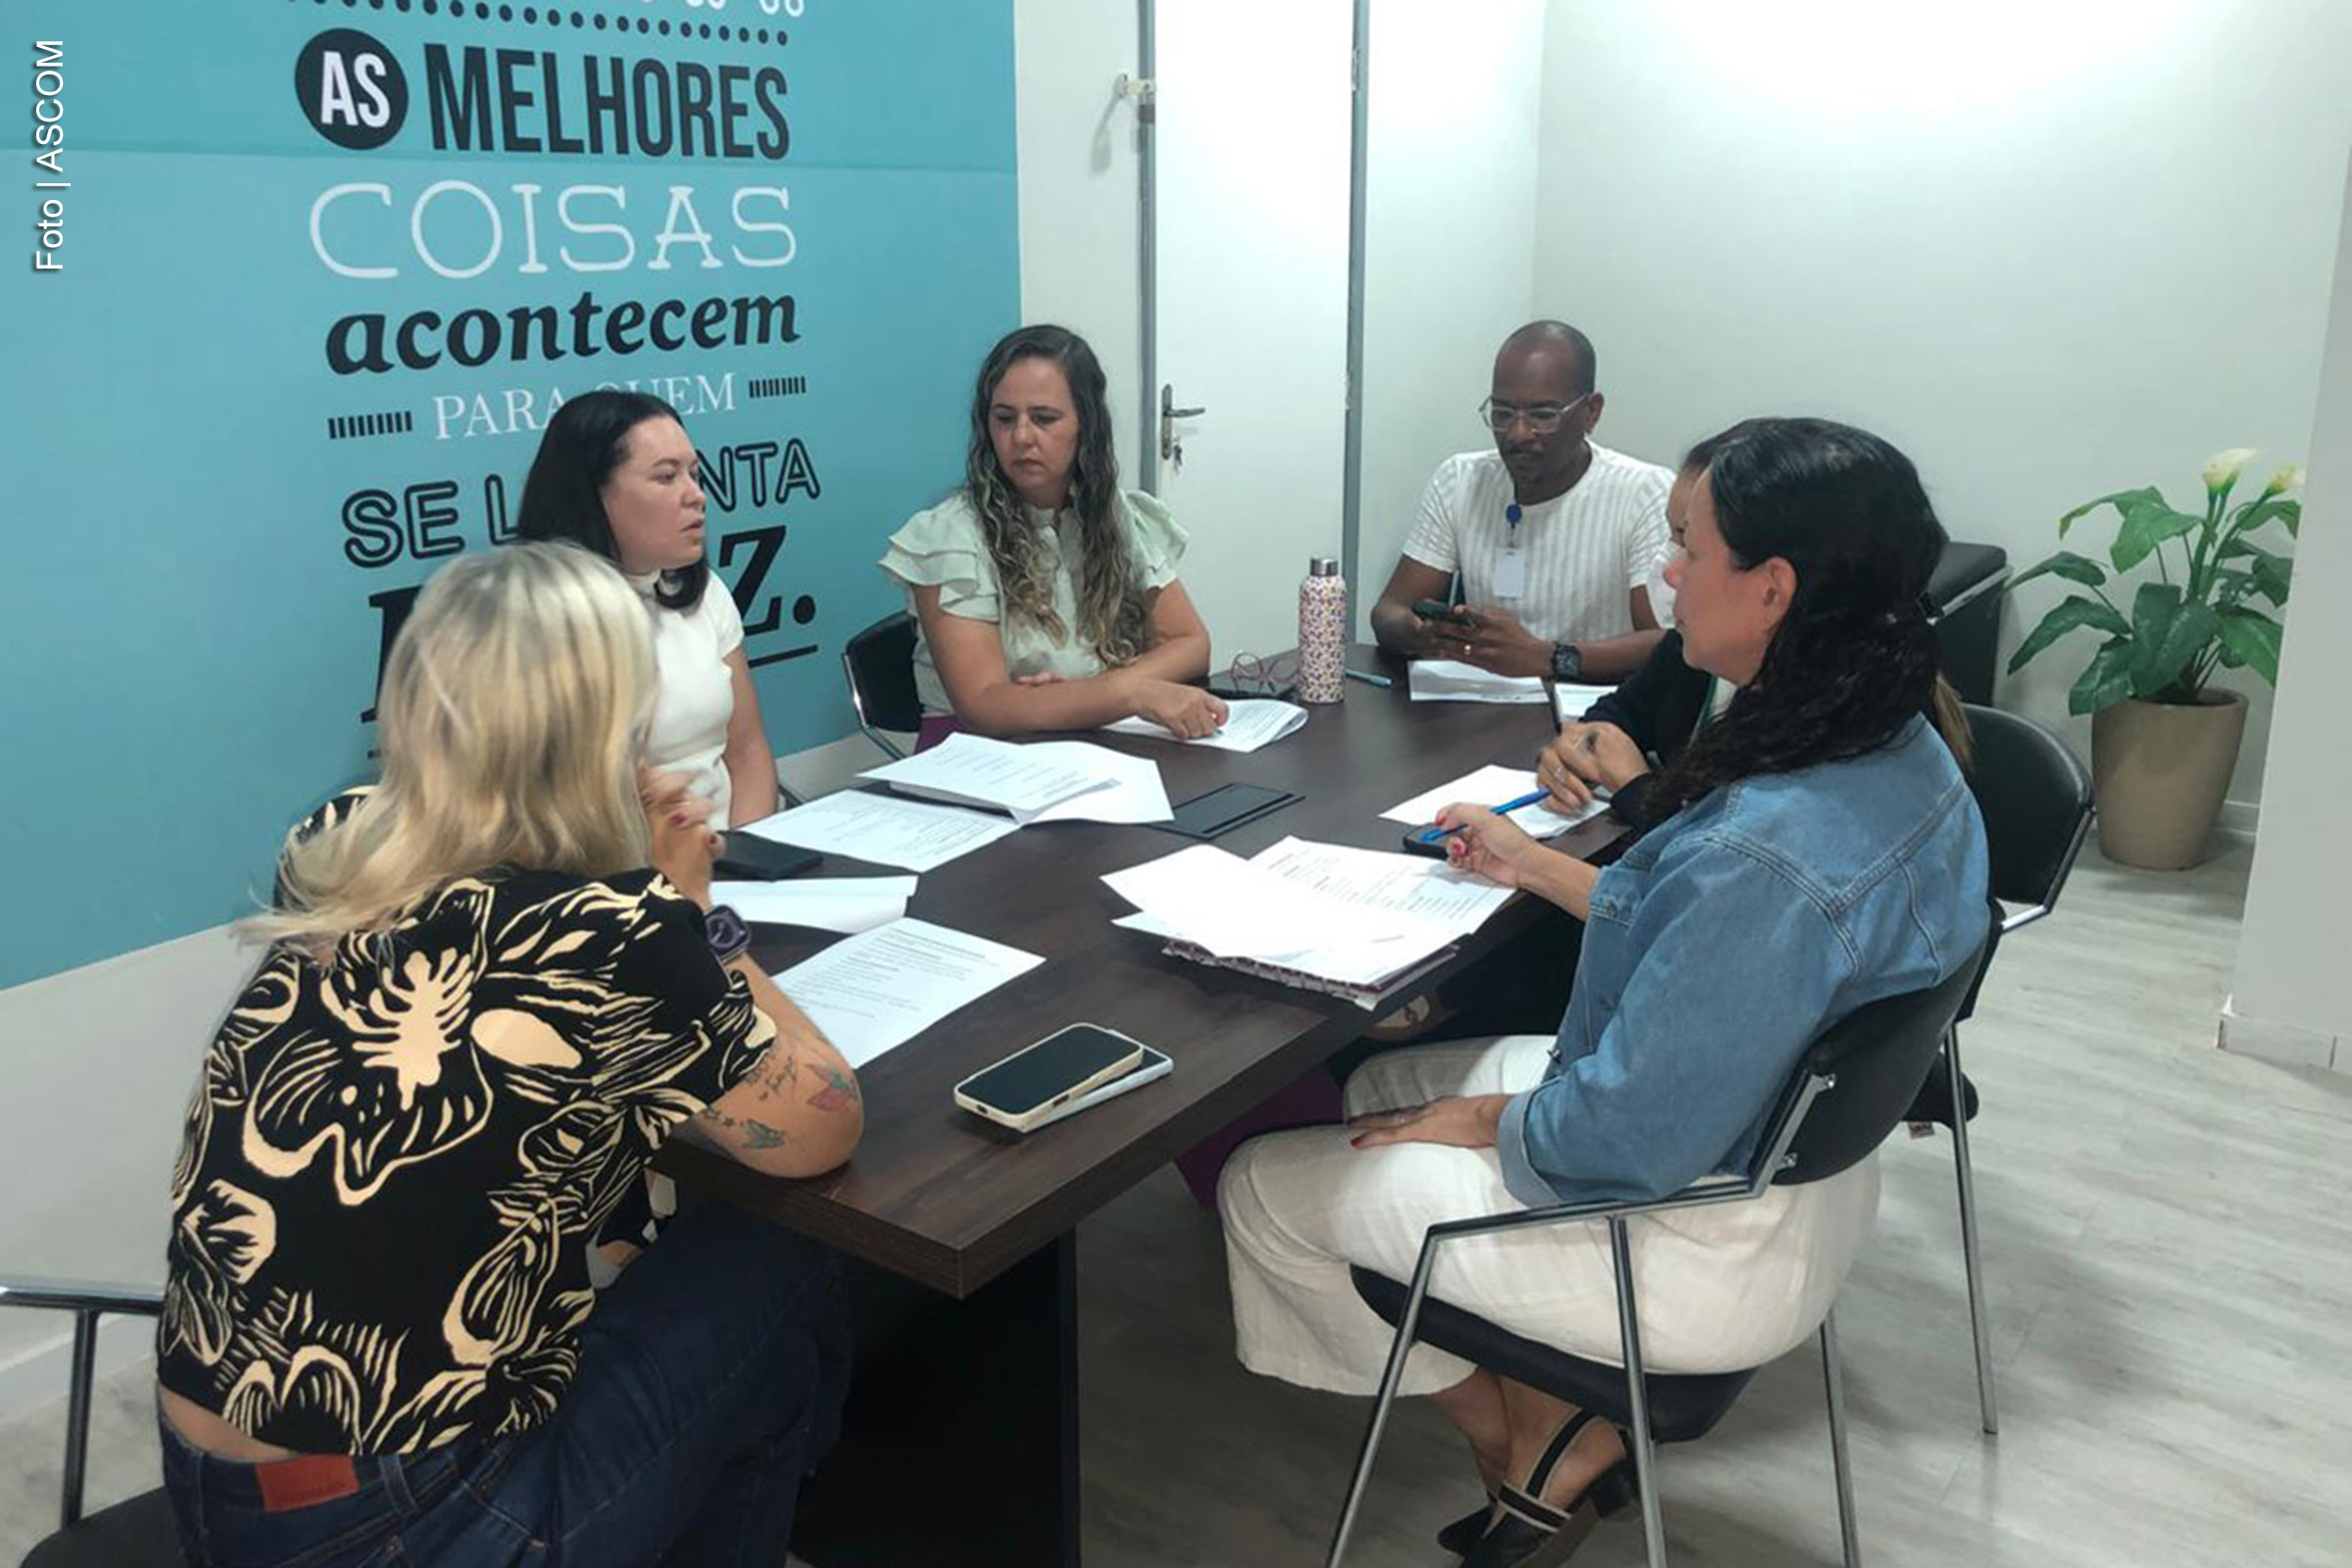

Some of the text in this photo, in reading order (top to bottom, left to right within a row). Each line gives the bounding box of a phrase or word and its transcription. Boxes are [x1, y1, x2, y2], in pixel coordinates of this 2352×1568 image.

[320, 42, 791, 161] AS MELHORES
[309, 179, 797, 279] COISAS
[325, 292, 802, 375] acontecem
[341, 480, 466, 568] SE
